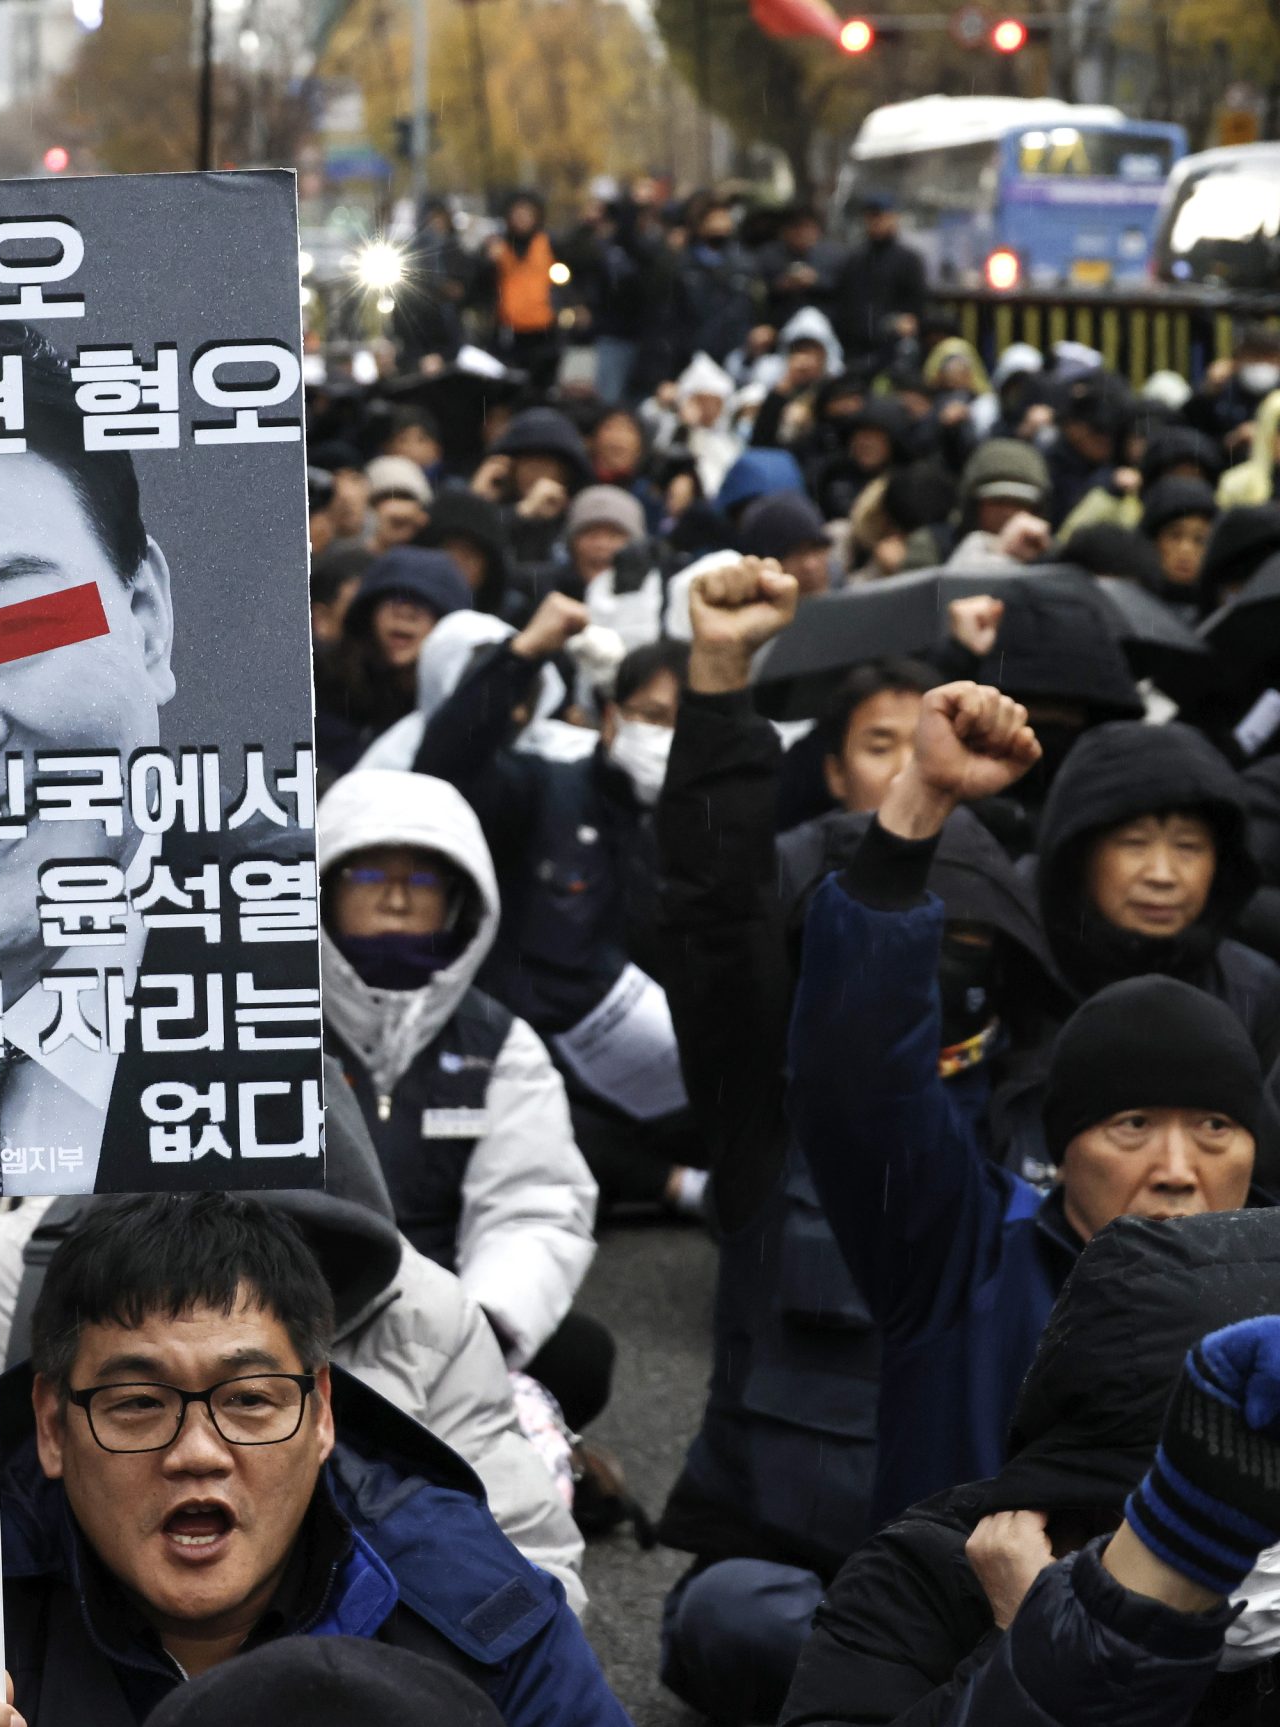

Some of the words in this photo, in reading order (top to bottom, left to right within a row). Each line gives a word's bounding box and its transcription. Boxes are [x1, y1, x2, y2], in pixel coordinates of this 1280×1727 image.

[70, 343, 302, 452] 혐오
[38, 859, 319, 948] 윤석열
[39, 970, 322, 1056] 자리는
[140, 1081, 326, 1165] 없다
